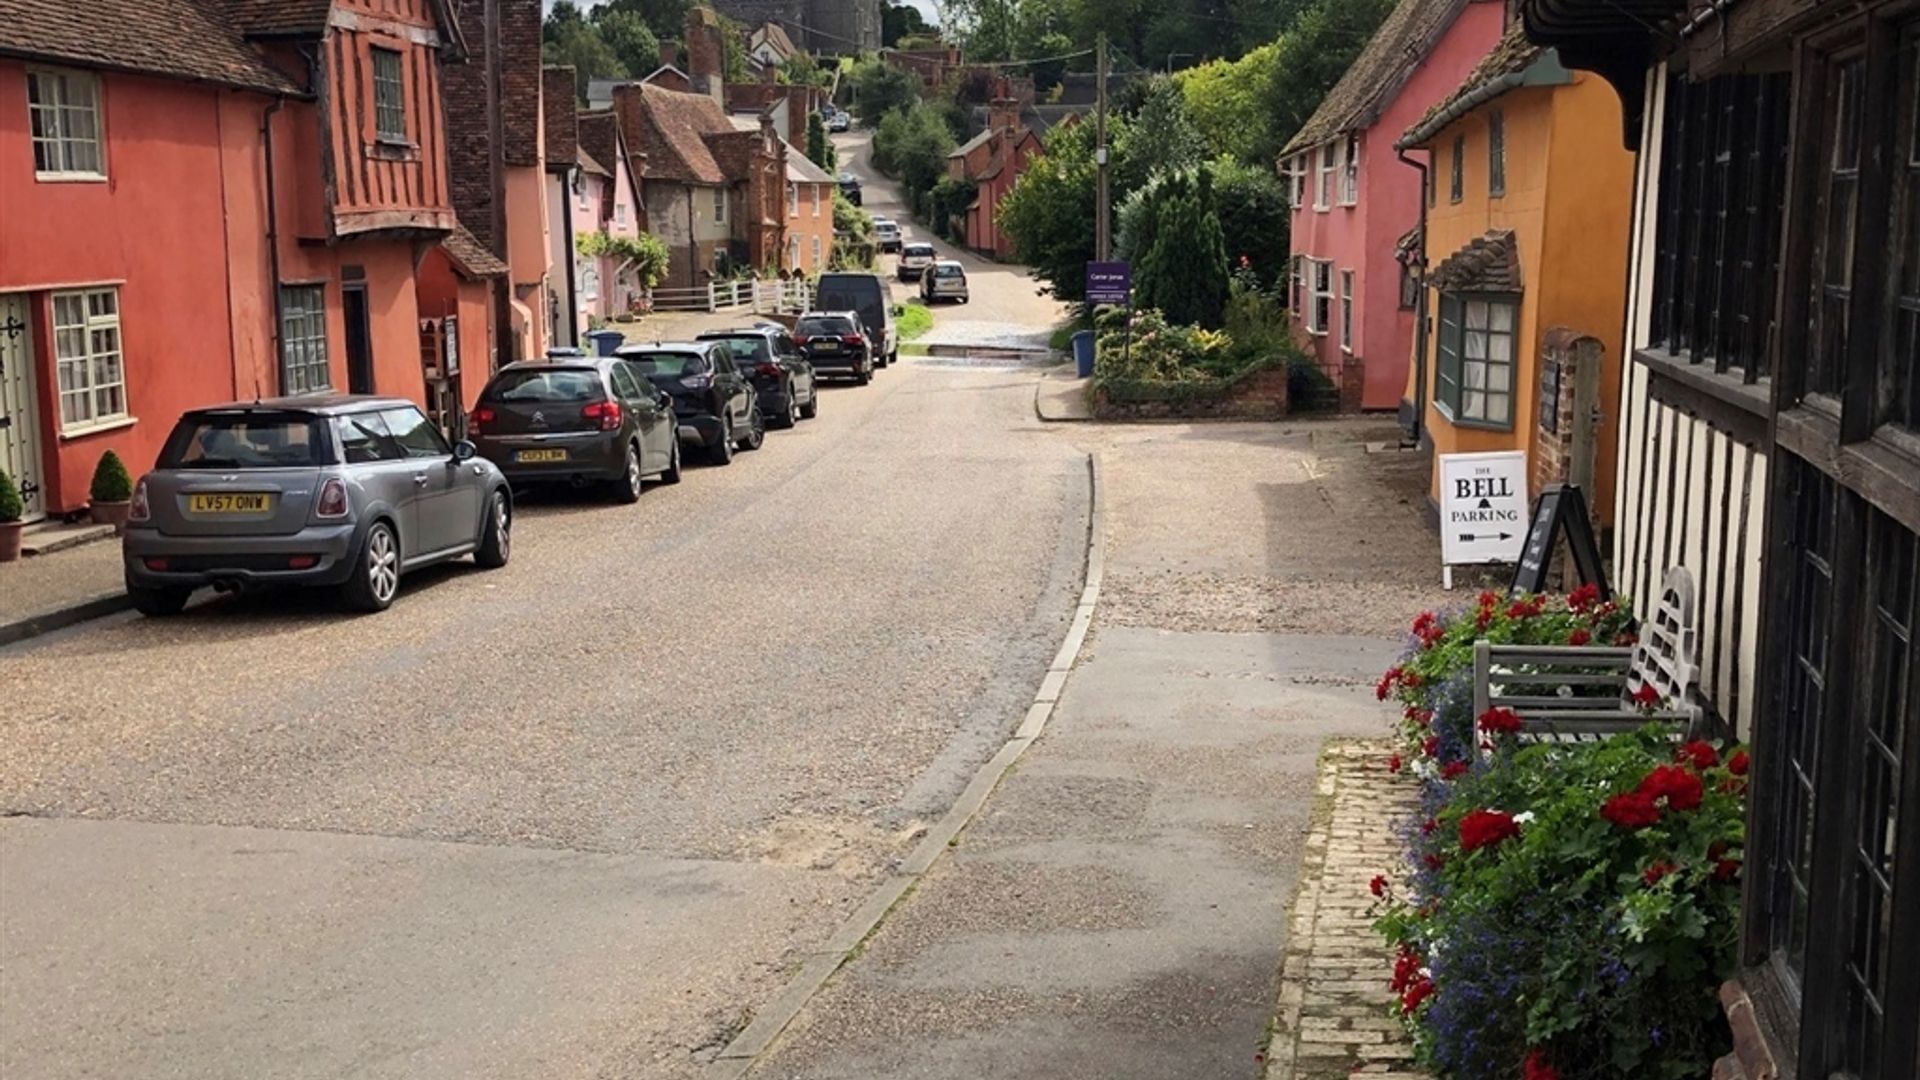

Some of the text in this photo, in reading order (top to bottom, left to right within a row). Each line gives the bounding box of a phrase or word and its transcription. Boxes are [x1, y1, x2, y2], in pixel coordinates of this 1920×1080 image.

[1455, 477, 1513, 498] BELL
[196, 496, 232, 510] LV57
[1451, 510, 1518, 522] PARKING
